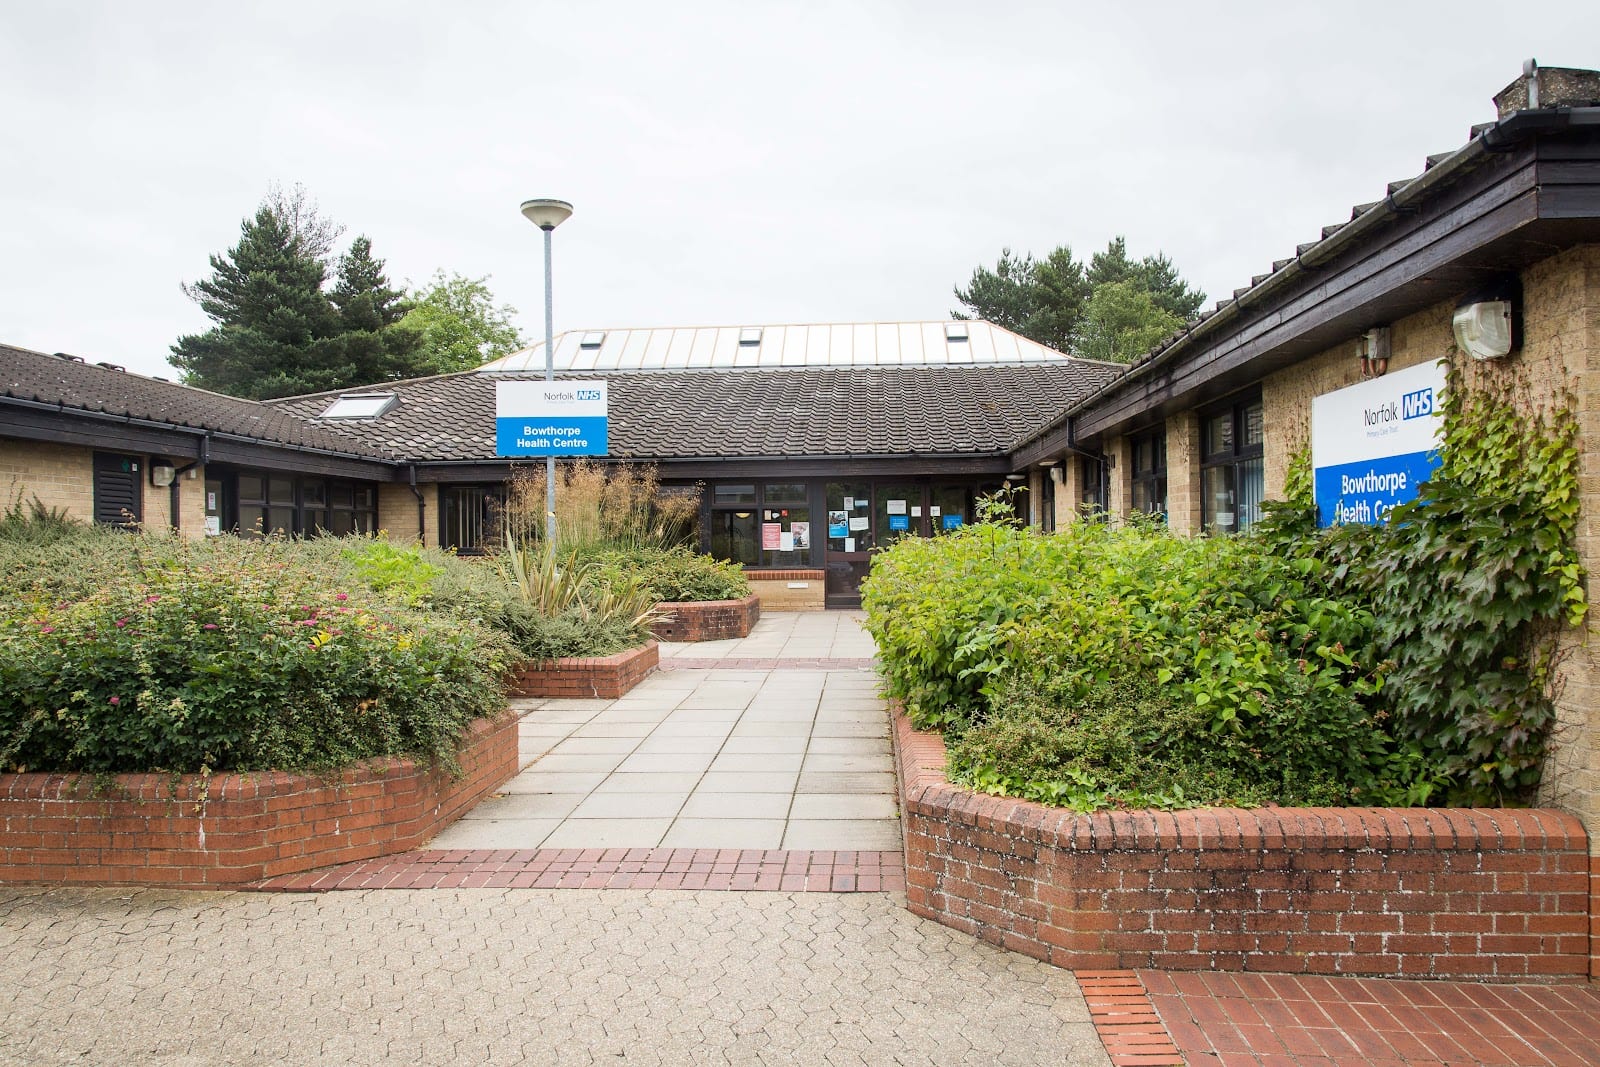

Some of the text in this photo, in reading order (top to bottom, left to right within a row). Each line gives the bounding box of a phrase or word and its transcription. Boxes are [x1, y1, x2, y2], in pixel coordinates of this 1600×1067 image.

[544, 391, 600, 400] Norfolk NHS
[1364, 388, 1432, 426] Norfolk NHS
[523, 426, 581, 437] Bowthorpe
[517, 439, 588, 448] Health Centre
[1341, 469, 1407, 496] Bowthorpe
[1335, 500, 1371, 523] Health
